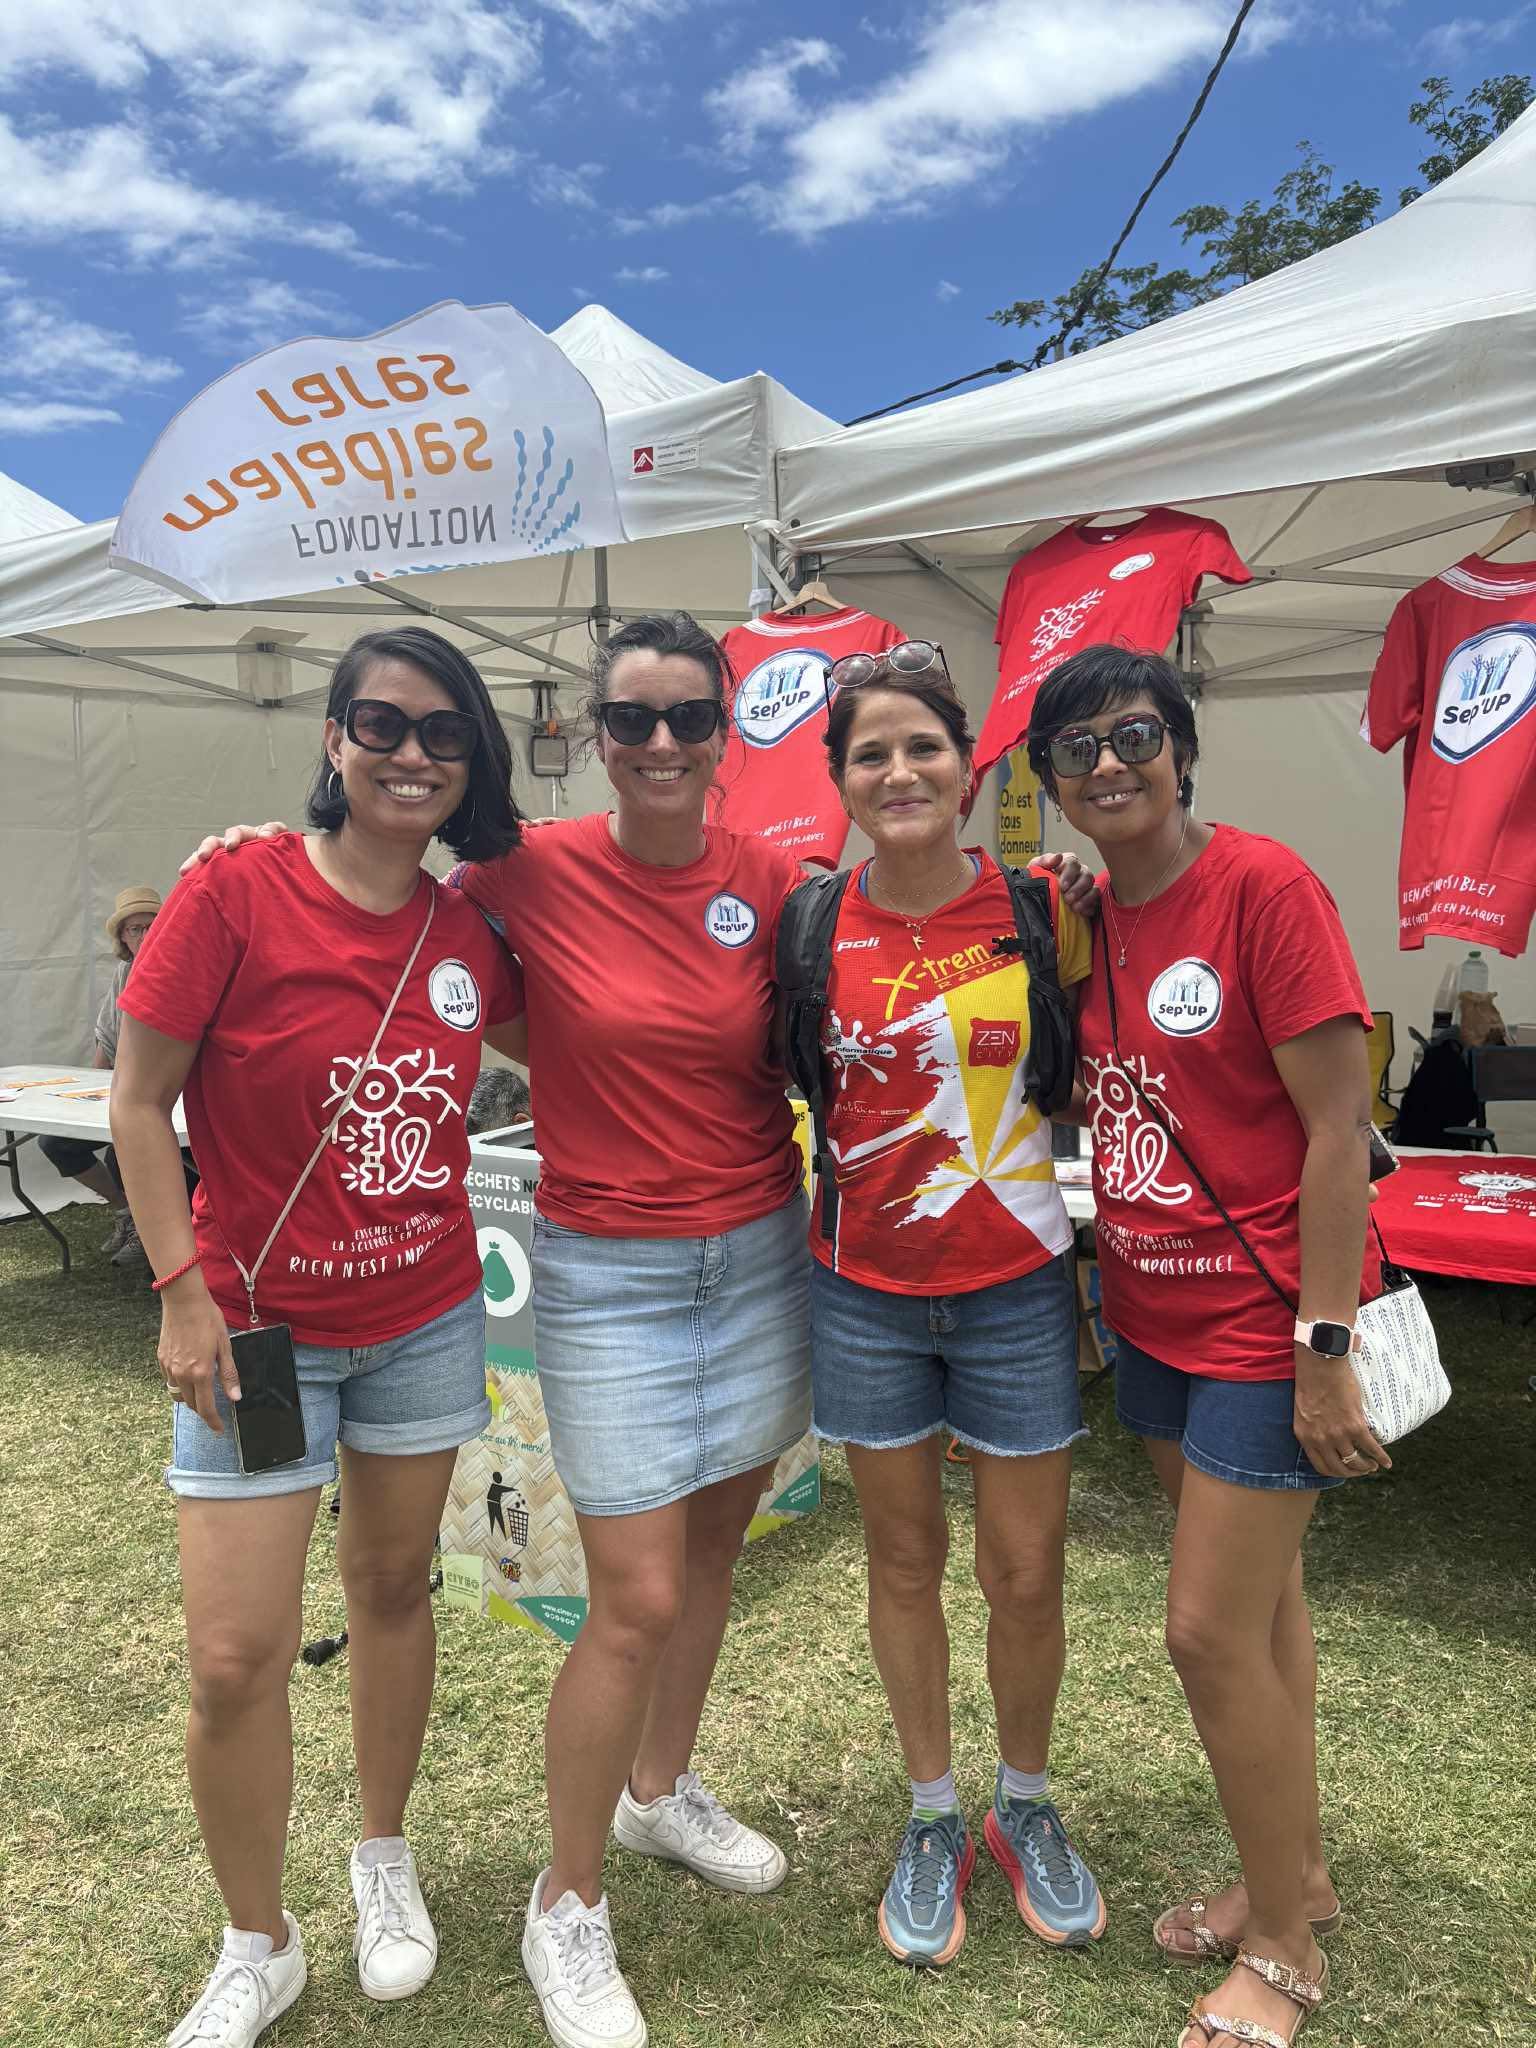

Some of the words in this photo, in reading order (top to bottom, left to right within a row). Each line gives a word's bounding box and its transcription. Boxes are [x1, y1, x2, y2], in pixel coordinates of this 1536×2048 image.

[750, 691, 811, 719] Sep'UP
[1442, 694, 1512, 726] Sep'UP
[1001, 789, 1014, 808] On
[1017, 792, 1032, 808] est
[1001, 813, 1021, 829] tous
[1459, 904, 1506, 926] PLAQUES
[713, 922, 748, 933] Sep'UP
[443, 1001, 475, 1015] Sep'UP
[1158, 1003, 1208, 1017] Sep'UP
[976, 1030, 1015, 1046] ZEN
[462, 1167, 520, 1192] ÉCHETS
[468, 1193, 535, 1215] ECYCLAB
[332, 1240, 344, 1251] LA
[289, 1256, 333, 1278] RIEN
[342, 1255, 388, 1279] N'EST
[1133, 1254, 1232, 1275] IMPOSSIBLE!
